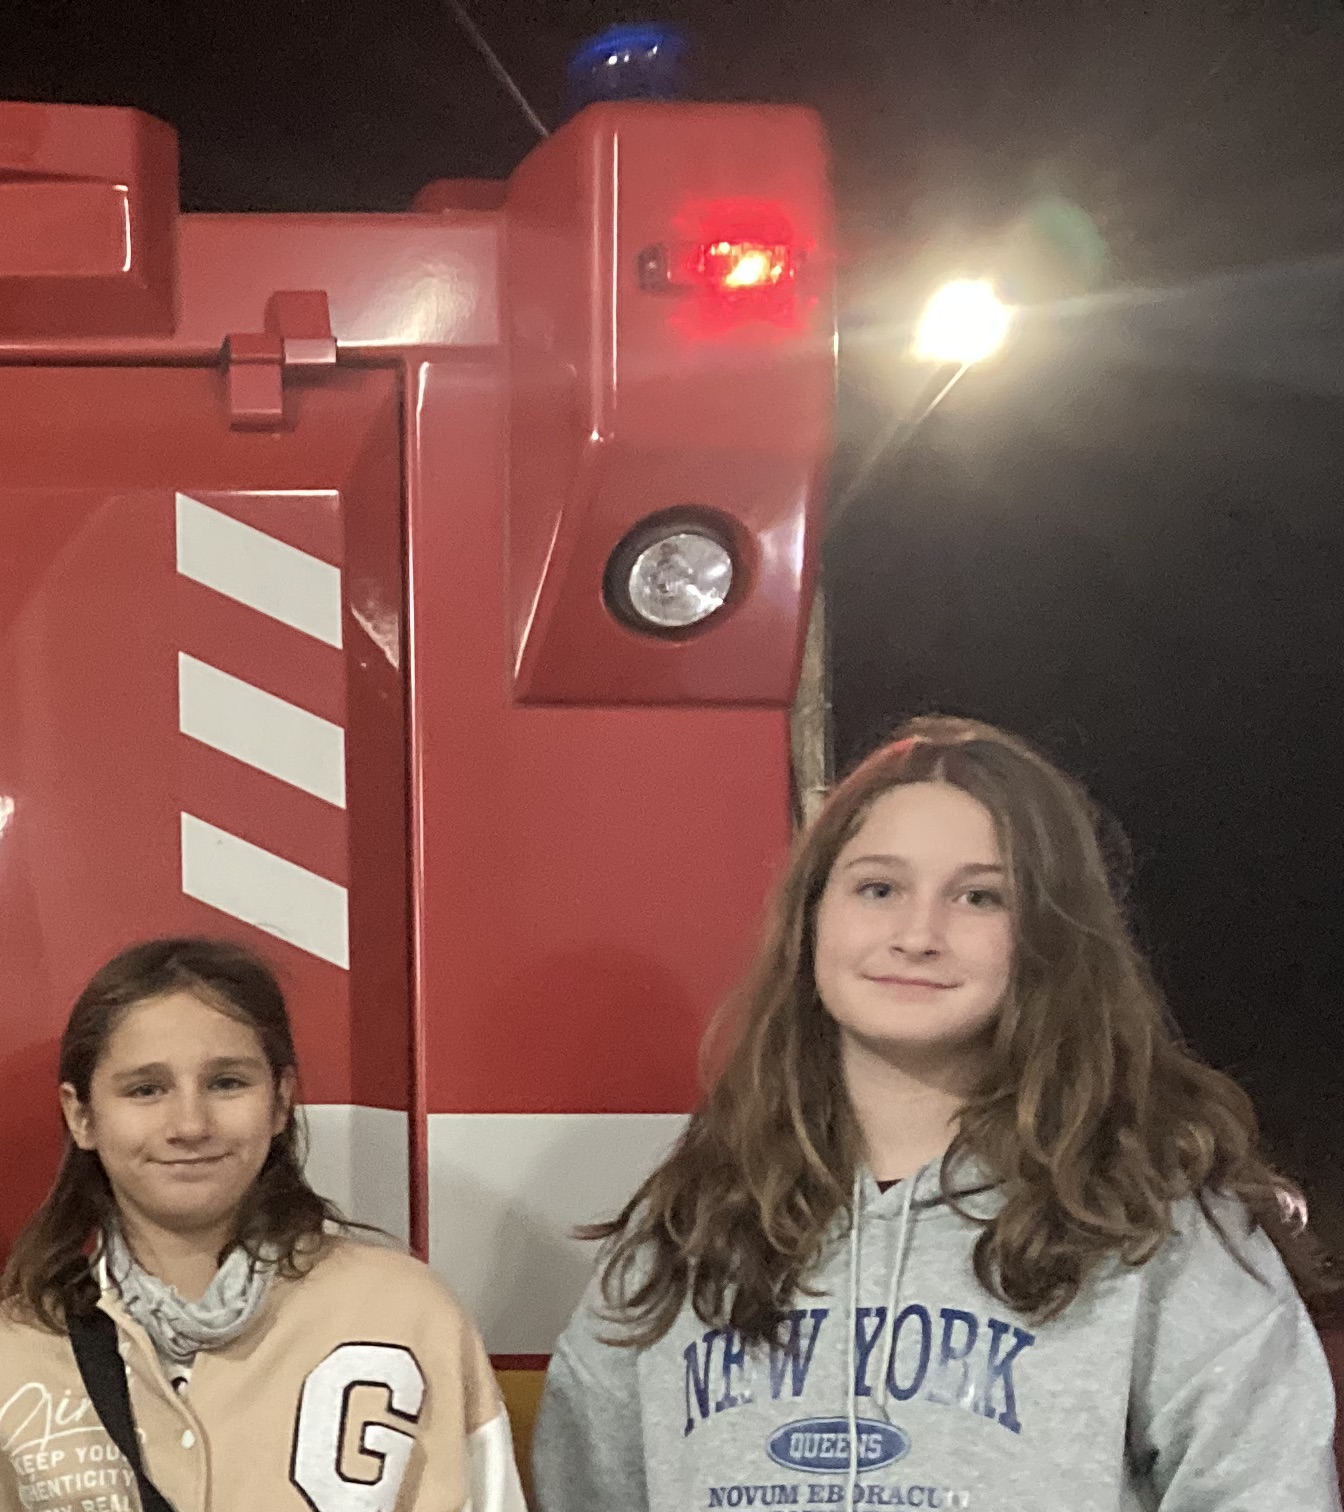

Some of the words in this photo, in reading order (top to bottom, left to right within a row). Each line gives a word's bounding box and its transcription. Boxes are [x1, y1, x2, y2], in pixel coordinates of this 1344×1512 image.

[855, 1303, 1036, 1434] YORK
[75, 1444, 128, 1464] YOU
[708, 1484, 799, 1508] NOVUM
